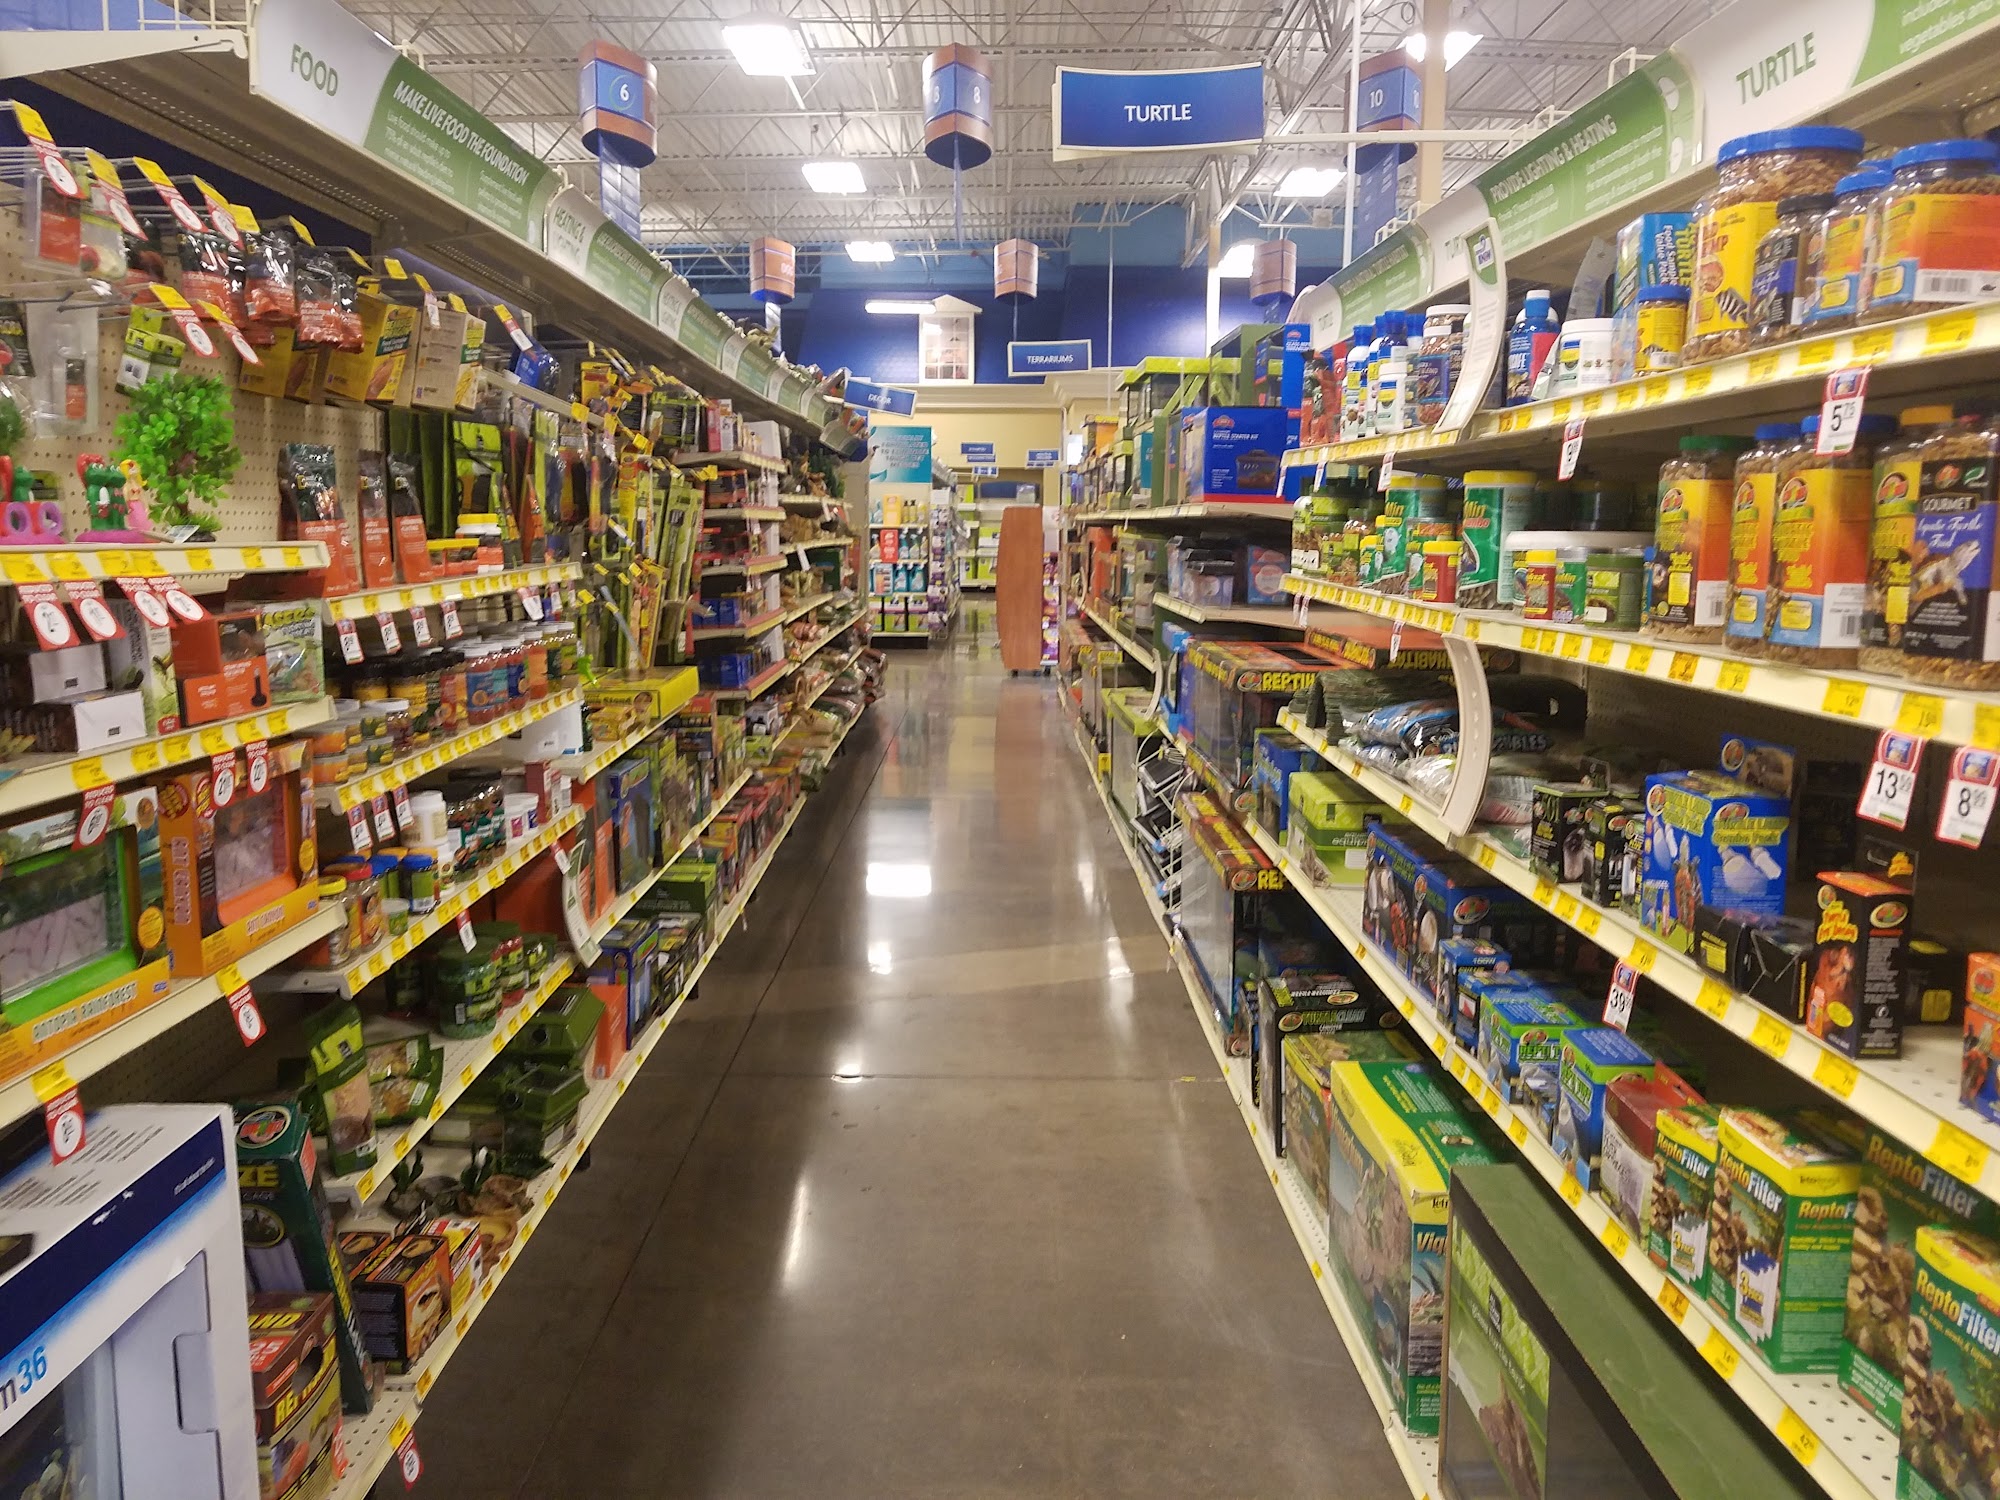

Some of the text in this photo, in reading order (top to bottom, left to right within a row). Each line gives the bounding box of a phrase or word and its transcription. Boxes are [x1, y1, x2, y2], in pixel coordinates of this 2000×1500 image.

[292, 44, 338, 97] FOOD
[1736, 32, 1817, 105] TURTLE
[620, 84, 630, 101] 6
[973, 86, 981, 104] 8
[1369, 89, 1384, 108] 10
[1124, 103, 1192, 123] TURTLE
[393, 80, 427, 117] MAKE
[423, 100, 444, 128] LIVE
[442, 113, 471, 144] FOOD
[467, 131, 486, 156] THE
[480, 143, 530, 186] FOUNDATION
[1490, 114, 1617, 204] PROVIDE LIGHTING & HEATING
[1655, 232, 1666, 260] Value
[1664, 225, 1679, 286] Food Sample
[1674, 229, 1693, 286] TURTLE
[1027, 354, 1073, 364] TERRARIUMS
[1922, 497, 1973, 512] GOURMET
[1947, 513, 1984, 531] Turtle
[1928, 531, 1956, 549] Food
[1876, 769, 1898, 800] 13
[1958, 788, 1971, 817] 8
[1657, 1132, 1711, 1179] ReptoFilter
[1719, 1146, 1782, 1213] ReptoFilter
[1867, 1135, 1979, 1219] ReptoFilter
[1673, 1231, 1683, 1251] 3
[1739, 1270, 1750, 1295] 3
[18, 1345, 47, 1396] 36
